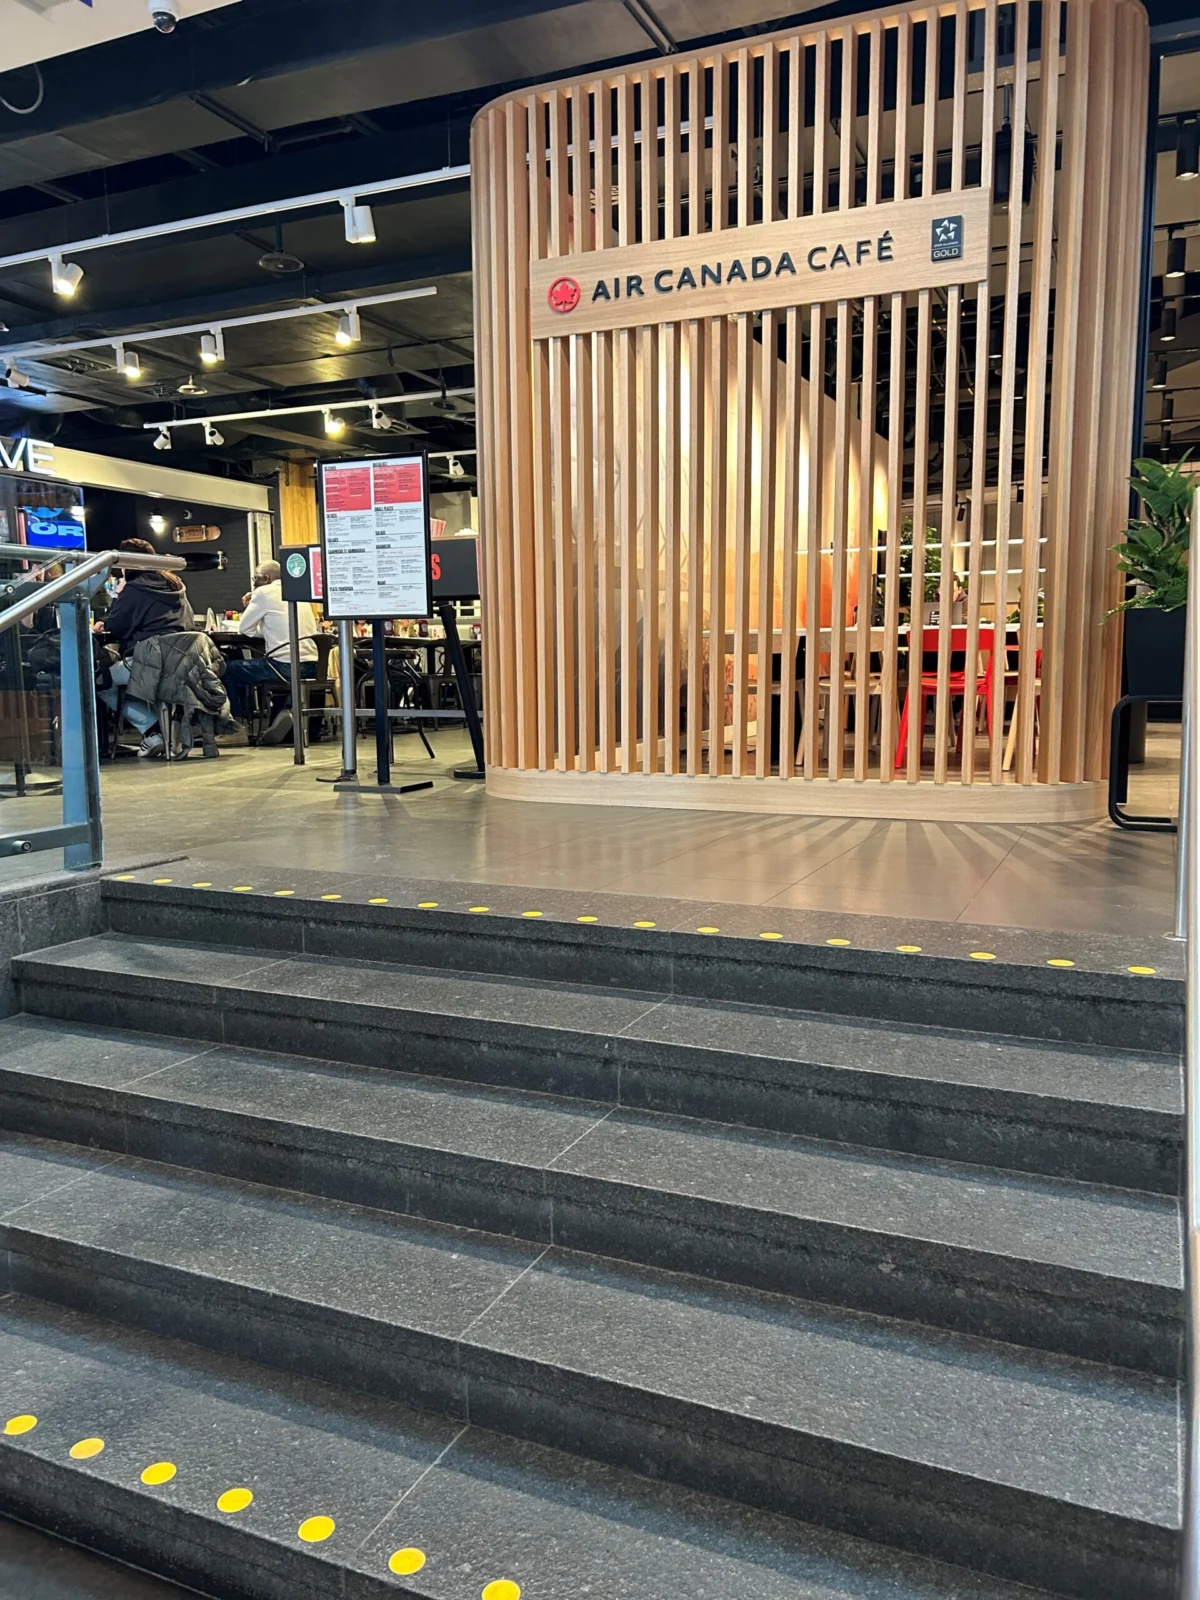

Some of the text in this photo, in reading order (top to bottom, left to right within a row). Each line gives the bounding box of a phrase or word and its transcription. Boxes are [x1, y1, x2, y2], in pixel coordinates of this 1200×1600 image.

[592, 230, 894, 302] AIR CANADA CAFÉ
[933, 247, 959, 258] GOLD
[0, 437, 56, 477] VE
